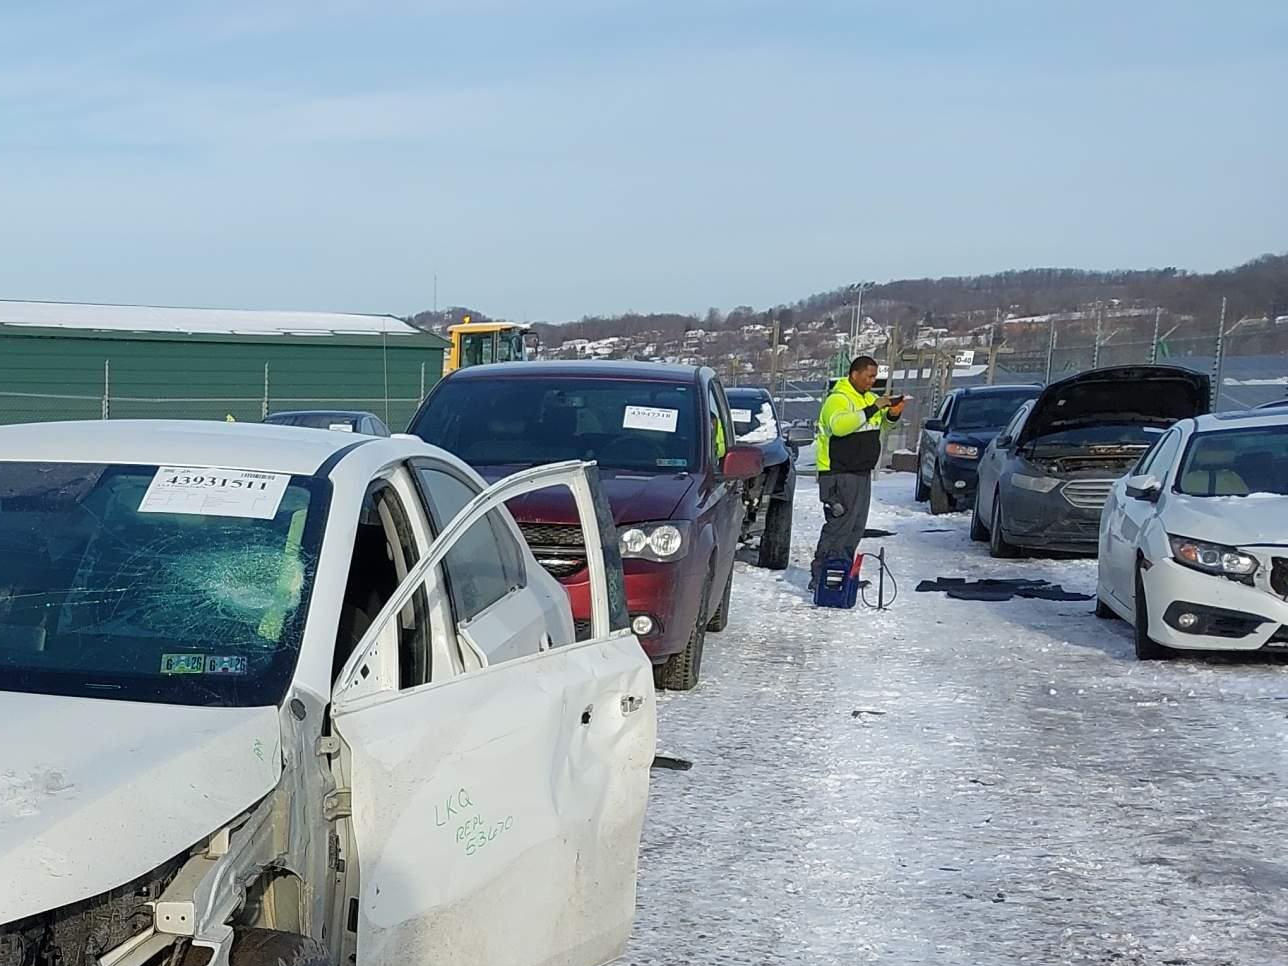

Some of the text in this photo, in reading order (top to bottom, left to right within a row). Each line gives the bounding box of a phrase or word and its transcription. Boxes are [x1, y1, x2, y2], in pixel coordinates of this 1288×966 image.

[166, 475, 268, 491] 43931511
[192, 656, 202, 671] 26
[434, 788, 473, 826] LKQ
